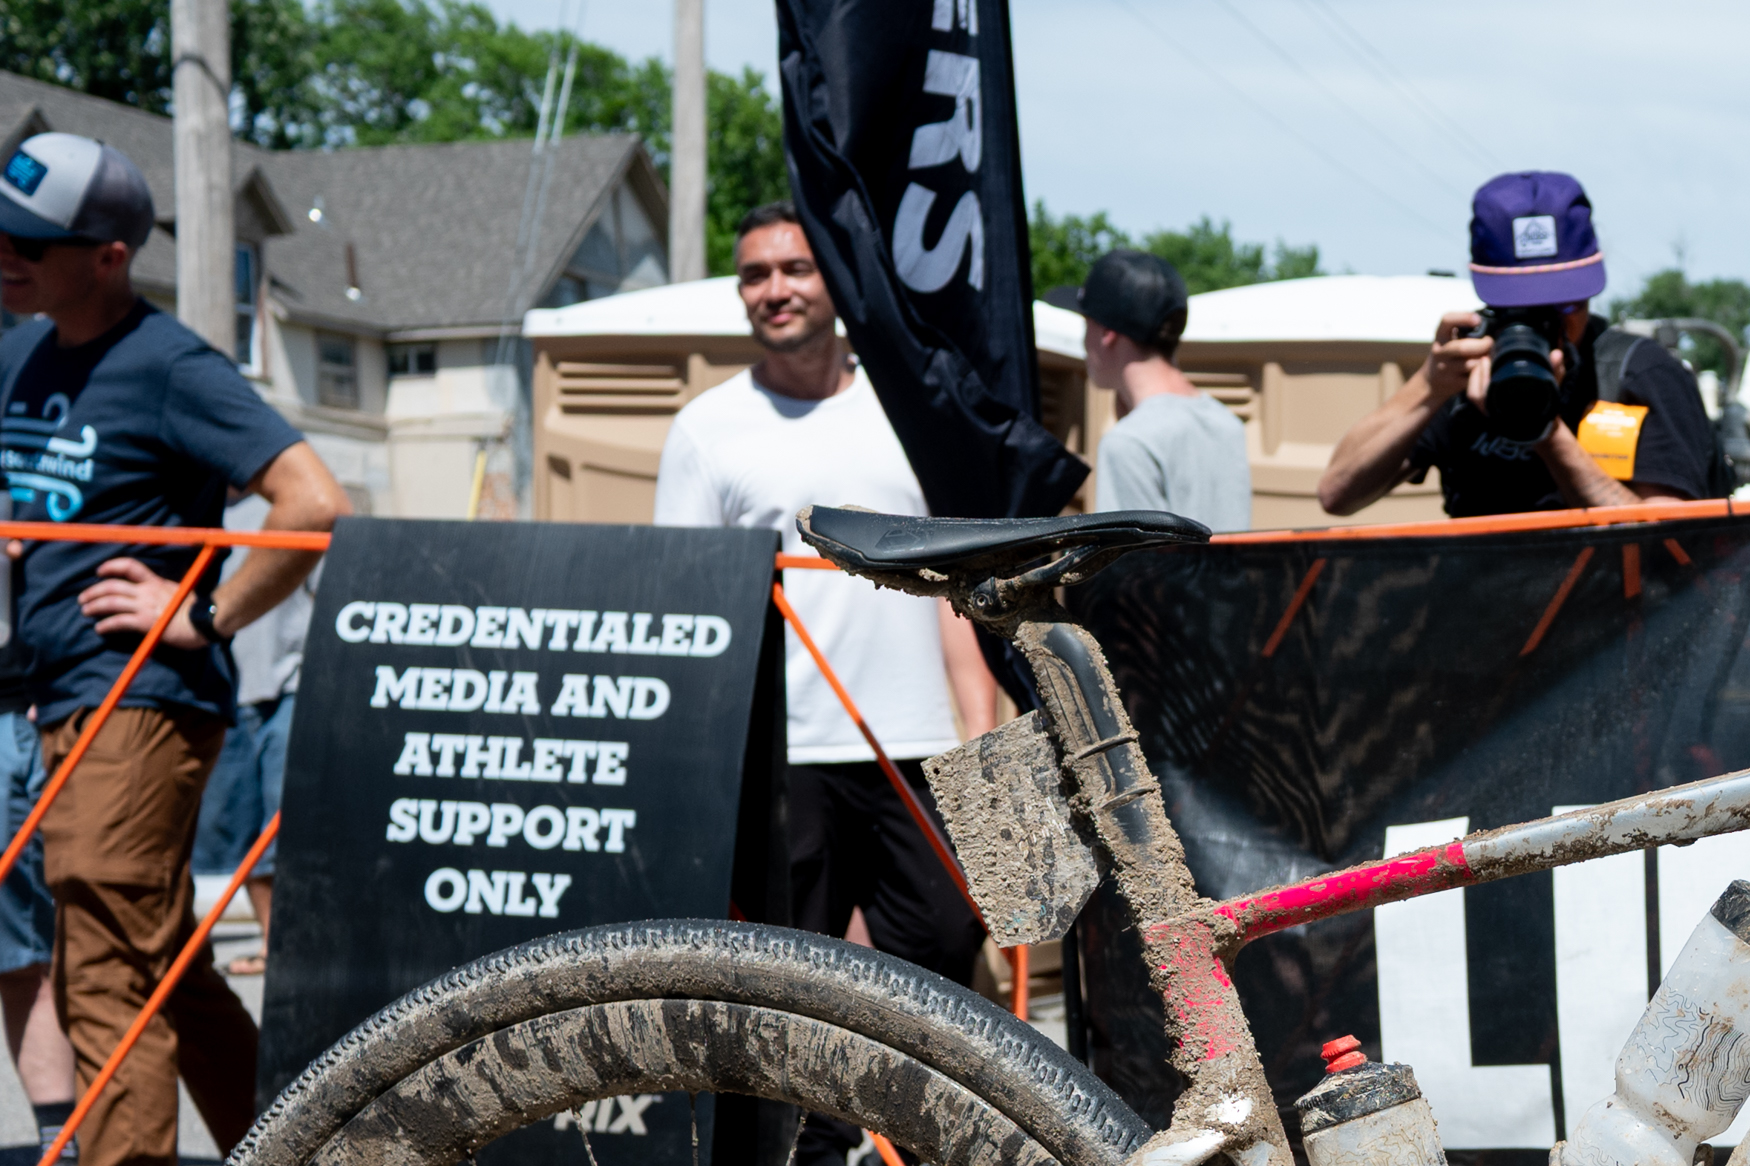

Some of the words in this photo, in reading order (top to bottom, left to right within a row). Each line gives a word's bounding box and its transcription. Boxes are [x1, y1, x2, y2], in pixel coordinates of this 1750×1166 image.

[335, 601, 732, 658] CREDENTIALED
[370, 666, 541, 716] MEDIA
[550, 674, 671, 721] AND
[394, 732, 629, 787] ATHLETE
[386, 798, 636, 853] SUPPORT
[424, 868, 573, 918] ONLY
